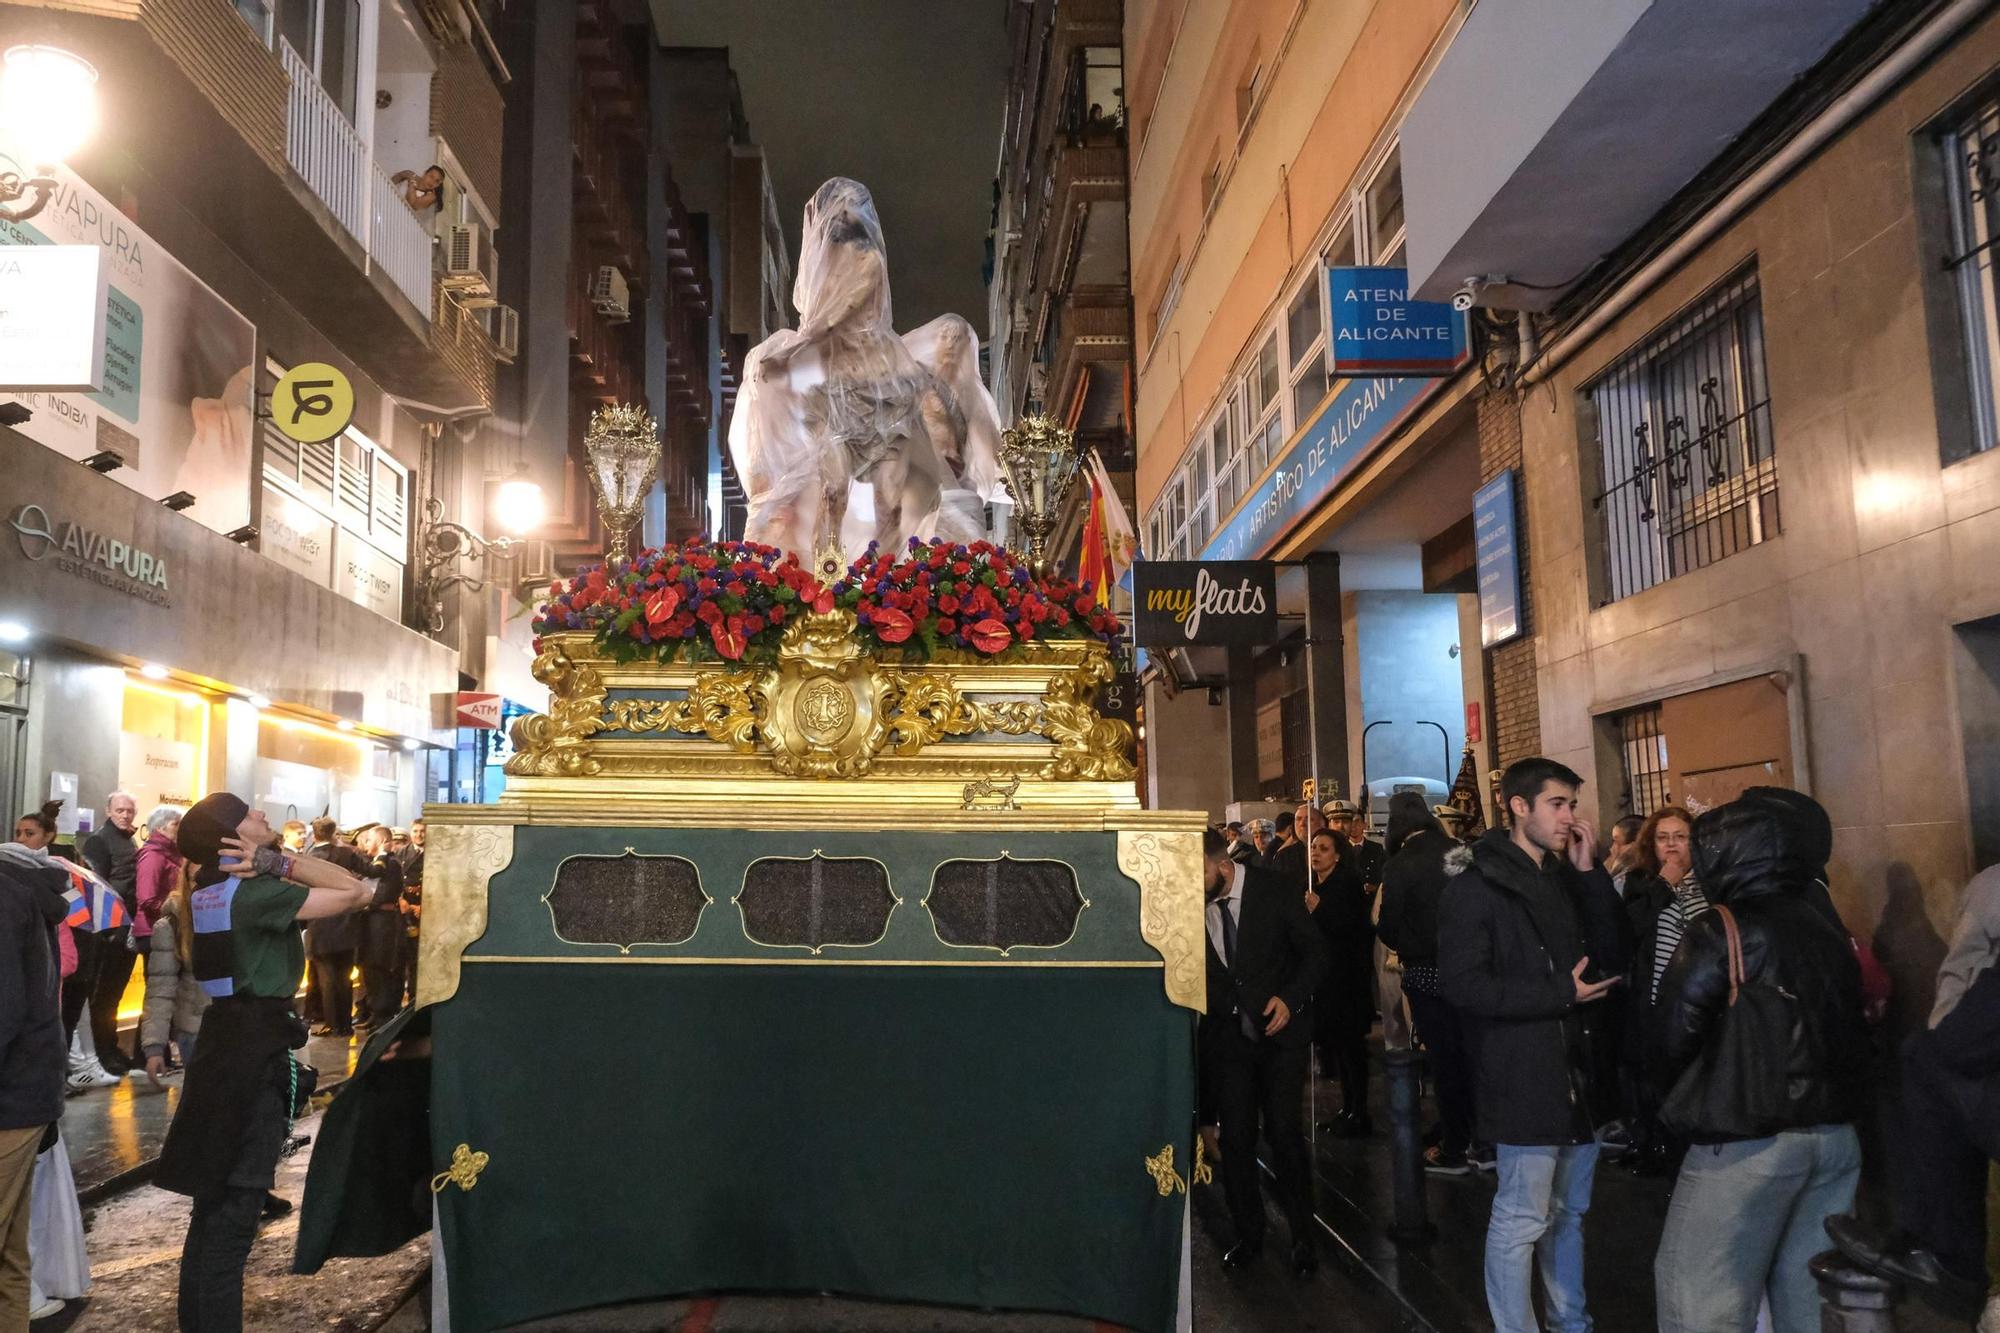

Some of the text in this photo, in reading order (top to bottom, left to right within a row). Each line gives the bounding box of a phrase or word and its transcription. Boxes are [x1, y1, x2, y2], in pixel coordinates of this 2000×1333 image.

[54, 182, 143, 274] VAPURA
[1376, 308, 1407, 321] DE
[1338, 327, 1450, 341] ALICANTE
[1308, 438, 1326, 477] DE
[61, 521, 169, 591] AVAPURA
[470, 704, 499, 717] ATM
